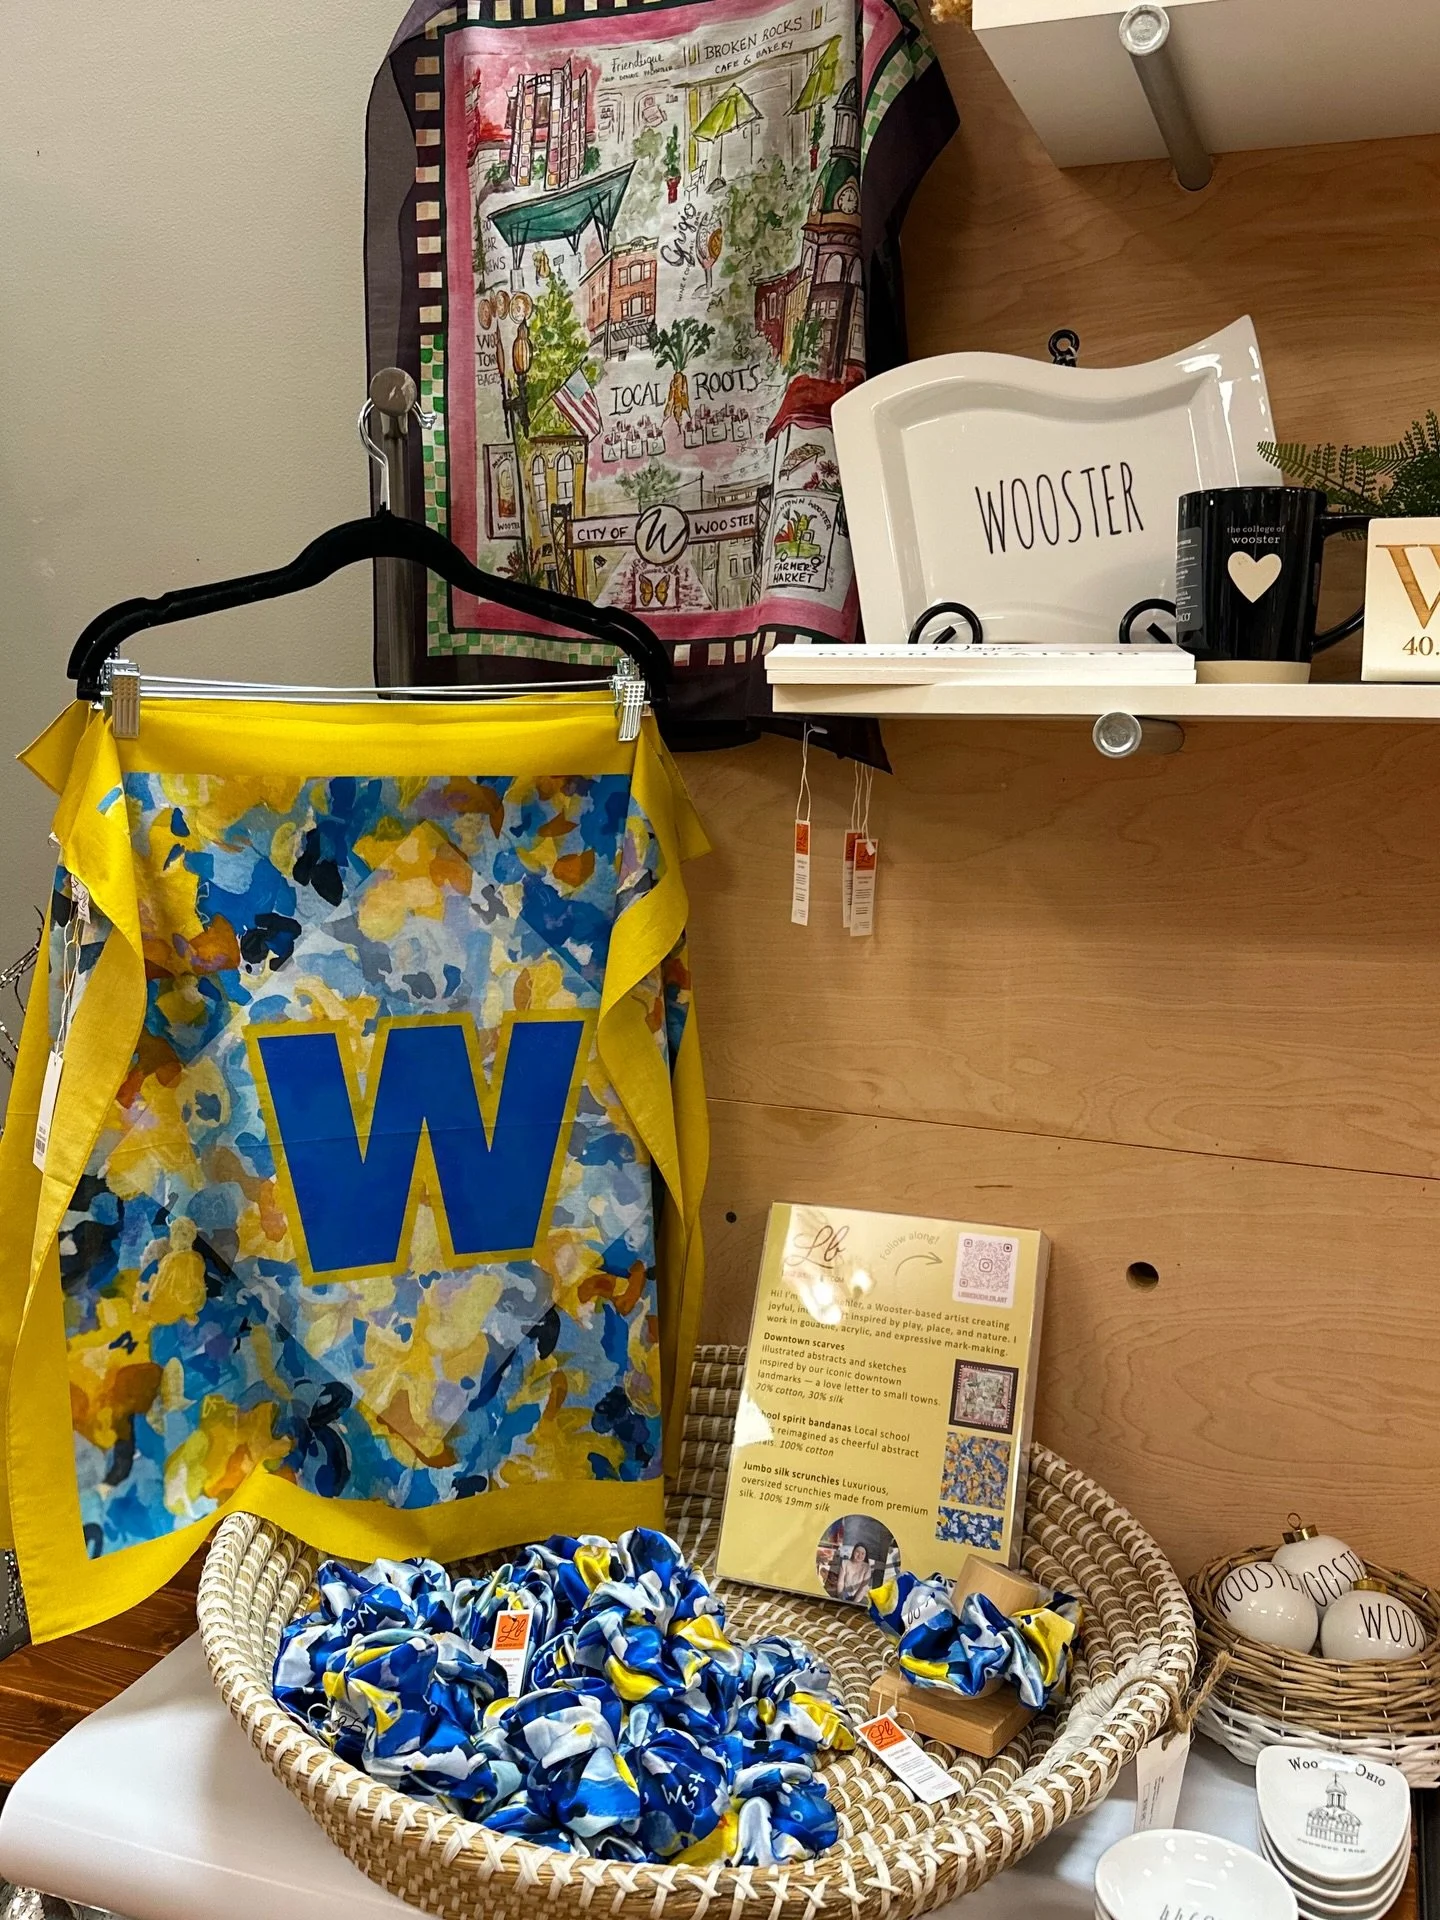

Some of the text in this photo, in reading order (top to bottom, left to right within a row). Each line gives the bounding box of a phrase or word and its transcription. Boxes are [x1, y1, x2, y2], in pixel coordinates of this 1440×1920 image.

[704, 17, 803, 60] BROKEN ROCKS
[714, 40, 793, 74] CAFE & BAKERY
[609, 365, 761, 416] LOCAL ROOTS
[973, 461, 1144, 555] WOOSTER
[577, 528, 606, 541] CITY
[610, 526, 629, 539] OF
[694, 513, 755, 535] WOOSTER
[1227, 524, 1286, 535] the college of
[1231, 536, 1281, 545] wooster
[772, 572, 815, 584] MARKET
[250, 1012, 595, 1282] W
[879, 1231, 940, 1260] Follow along!
[768, 1302, 795, 1314] joyful,
[851, 1312, 887, 1325] inspired
[889, 1318, 900, 1328] by
[902, 1319, 924, 1332] play,
[926, 1323, 954, 1336] place,
[956, 1328, 974, 1338] and
[976, 1331, 1010, 1344] nature.
[770, 1289, 783, 1298] Hi!
[785, 1290, 798, 1300] I'm
[875, 1303, 942, 1320] Wooster-based
[944, 1312, 970, 1325] artist
[972, 1316, 1011, 1332] creating
[763, 1332, 845, 1351] Downtown scarves
[766, 1314, 787, 1324] work
[789, 1316, 798, 1325] in
[841, 1324, 873, 1337] acrylic,
[875, 1330, 892, 1340] and
[894, 1332, 942, 1347] expressive
[944, 1340, 1009, 1358] mark-making.
[759, 1357, 902, 1386] inspired by our iconic downtown
[807, 1350, 847, 1365] abstracts
[849, 1357, 866, 1368] and
[868, 1360, 907, 1374] sketches
[755, 1382, 845, 1404] 70% cotton, 30% silk
[757, 1370, 801, 1384] landmarks
[823, 1380, 842, 1390] love
[844, 1382, 869, 1395] letter
[871, 1388, 881, 1397] to
[883, 1390, 908, 1401] small
[910, 1394, 941, 1406] towns.
[777, 1427, 827, 1442] reimagined
[828, 1436, 839, 1445] as
[841, 1437, 880, 1451] cheerful
[881, 1444, 920, 1458] abstract
[782, 1414, 806, 1426] spirit
[808, 1417, 852, 1433] bandanas
[854, 1425, 878, 1437] Local
[880, 1430, 911, 1443] school
[779, 1440, 803, 1452] 100%
[805, 1445, 835, 1457] cotton
[743, 1461, 889, 1497] Jumbo silk scrunchies Luxurious,
[739, 1489, 831, 1513] silk. 100% 19mm silk
[741, 1476, 929, 1516] oversized scrunchies made from premium
[1355, 1763, 1386, 1787] OHIO
